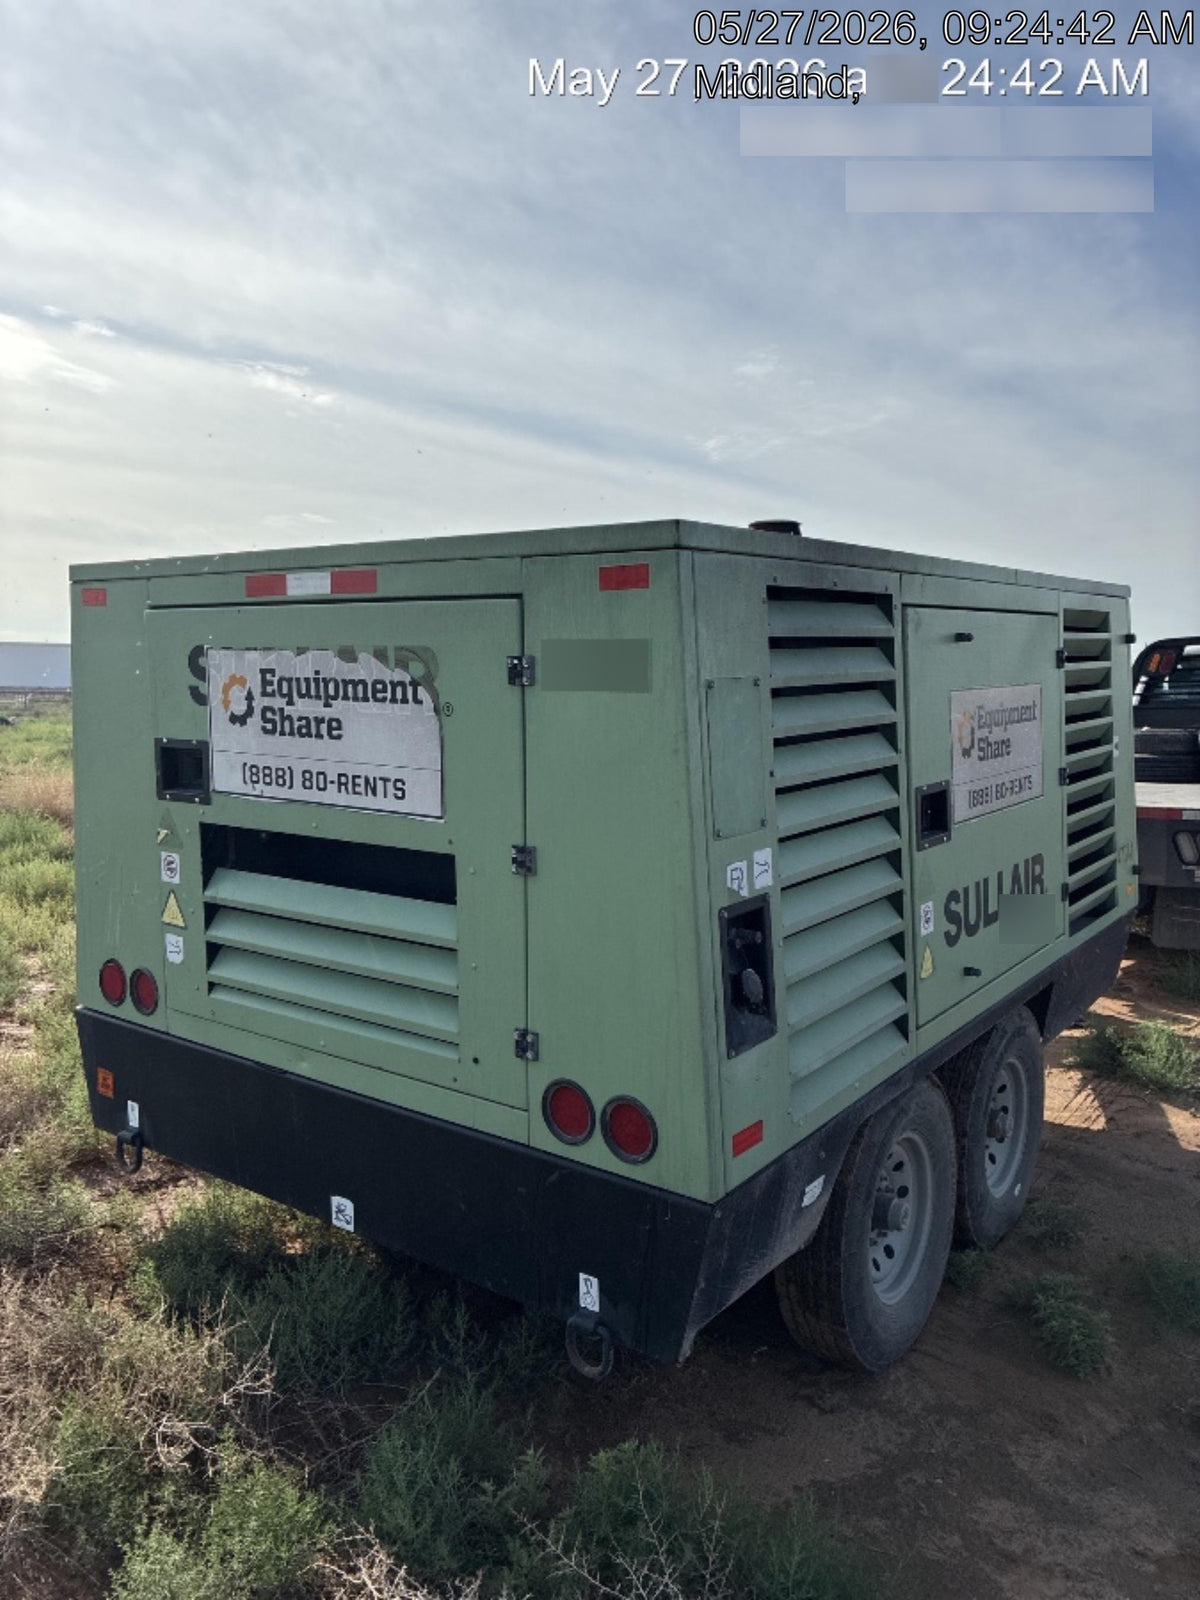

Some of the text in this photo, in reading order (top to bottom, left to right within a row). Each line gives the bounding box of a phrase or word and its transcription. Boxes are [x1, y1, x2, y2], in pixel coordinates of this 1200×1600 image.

[259, 668, 424, 707] Equipment
[260, 706, 343, 740] Share
[976, 700, 1037, 734] Equipment
[977, 736, 1012, 761] Share
[243, 762, 406, 801] (888) 80-RENTS
